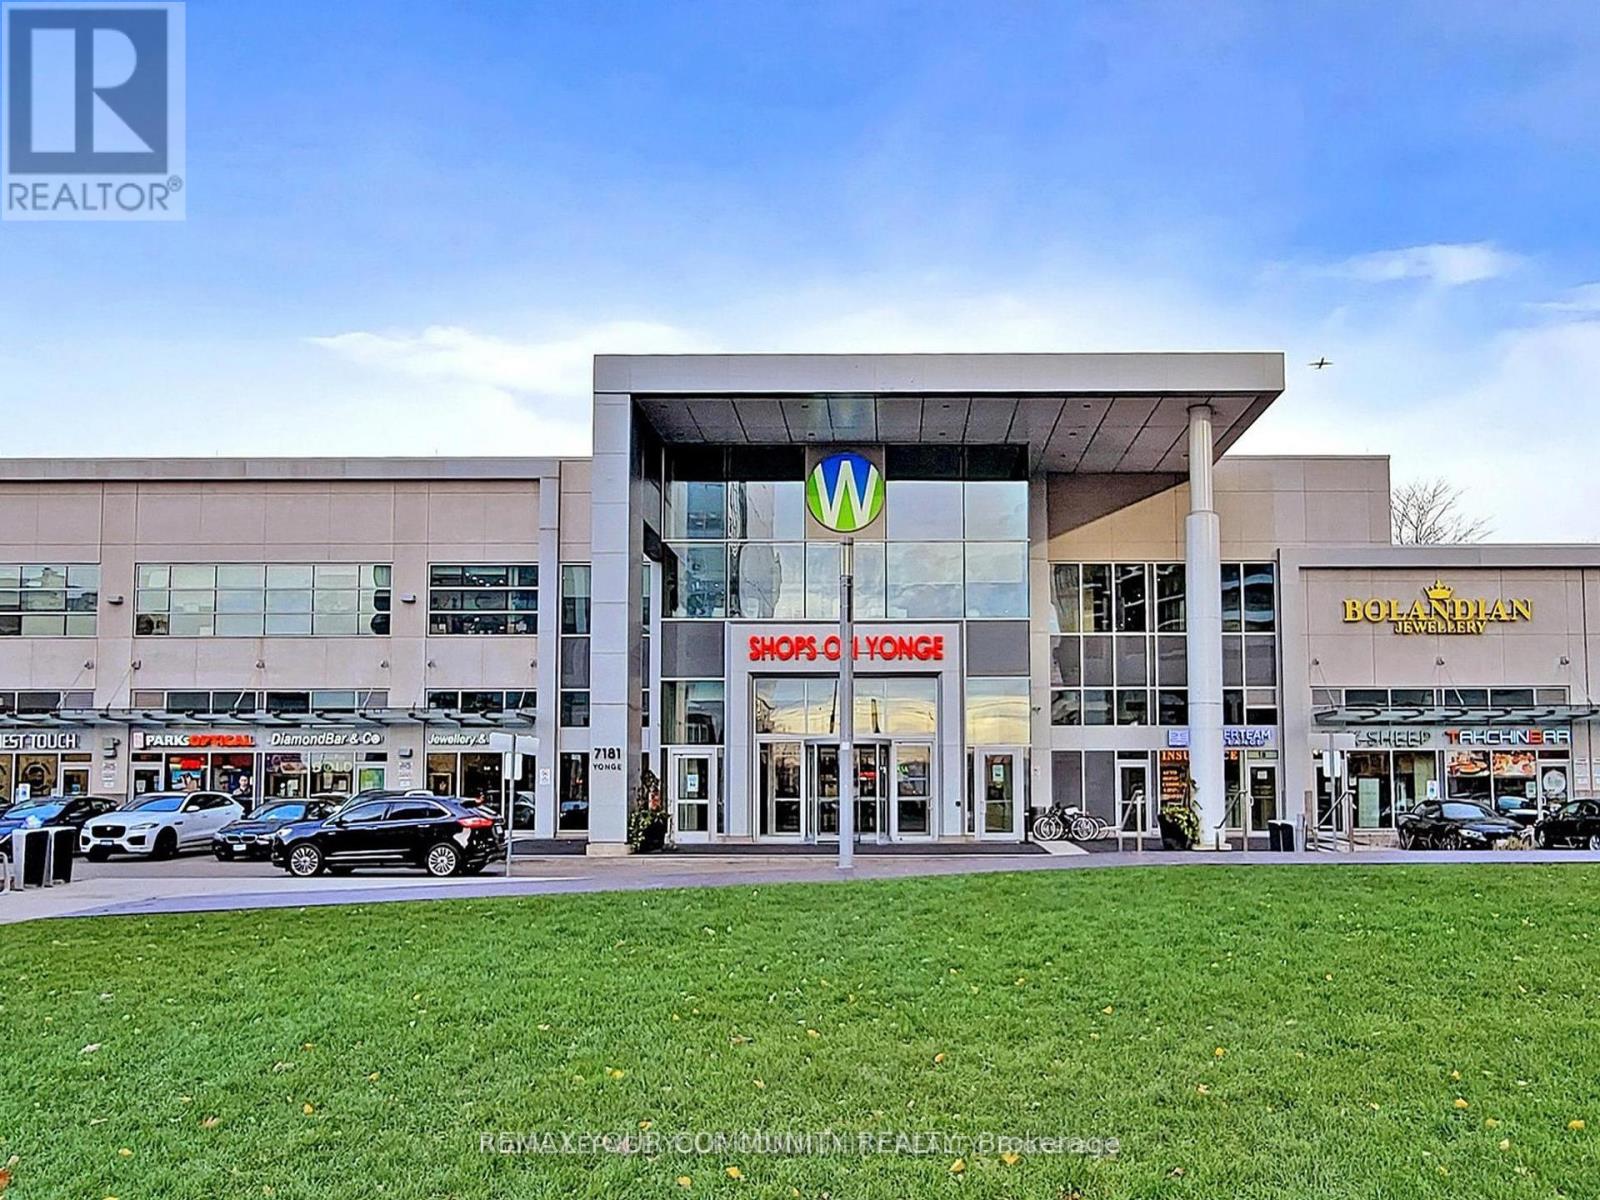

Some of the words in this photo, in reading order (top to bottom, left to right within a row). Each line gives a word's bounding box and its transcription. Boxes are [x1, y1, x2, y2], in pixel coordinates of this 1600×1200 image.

[1343, 597, 1533, 622] BOLANDIAN
[1394, 620, 1487, 635] JEWELLERY
[748, 635, 818, 661] SHOPS
[865, 635, 944, 661] YONGE
[30, 733, 76, 749] TOUCH
[594, 748, 621, 760] 7181
